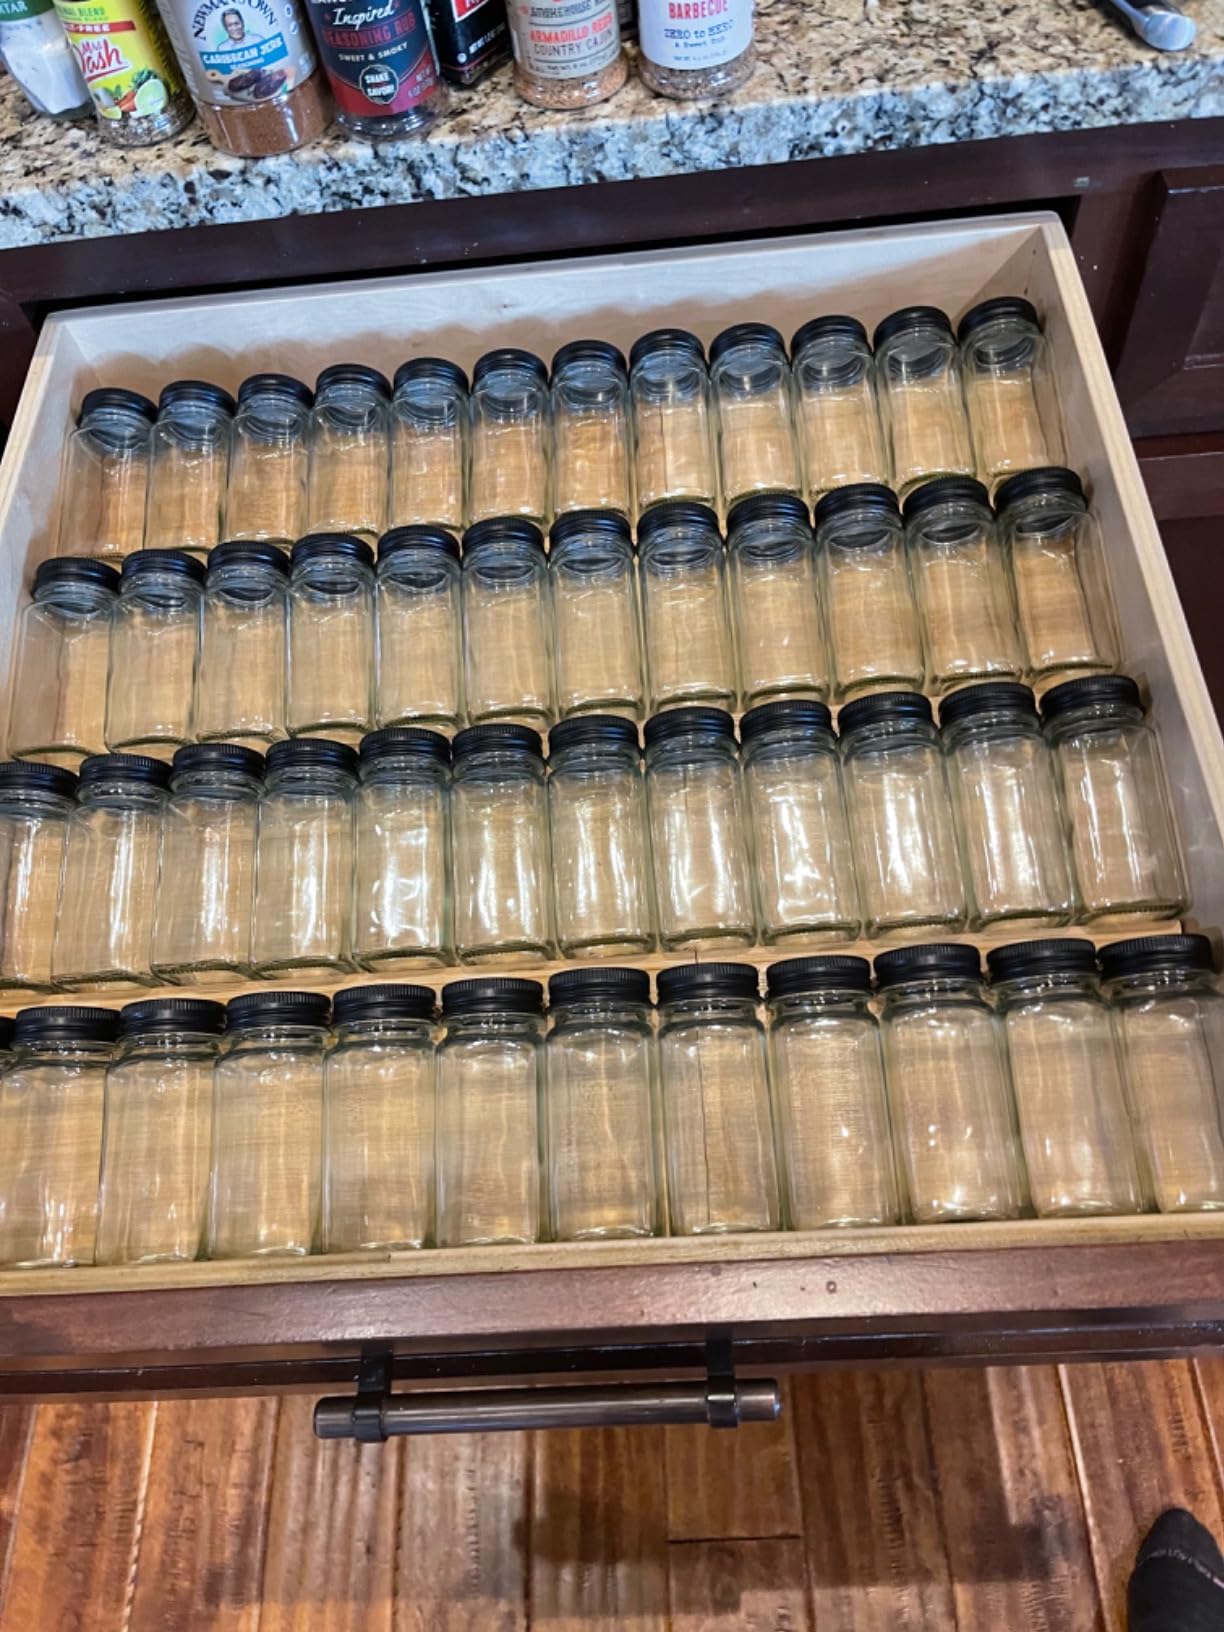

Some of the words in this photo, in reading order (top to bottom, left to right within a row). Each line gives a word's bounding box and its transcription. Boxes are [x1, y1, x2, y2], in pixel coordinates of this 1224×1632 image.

[332, 0, 394, 31] Inspired
[669, 0, 728, 19] BARBECUE
[377, 41, 408, 60] SMOKY
[534, 43, 581, 56] COUNTRY
